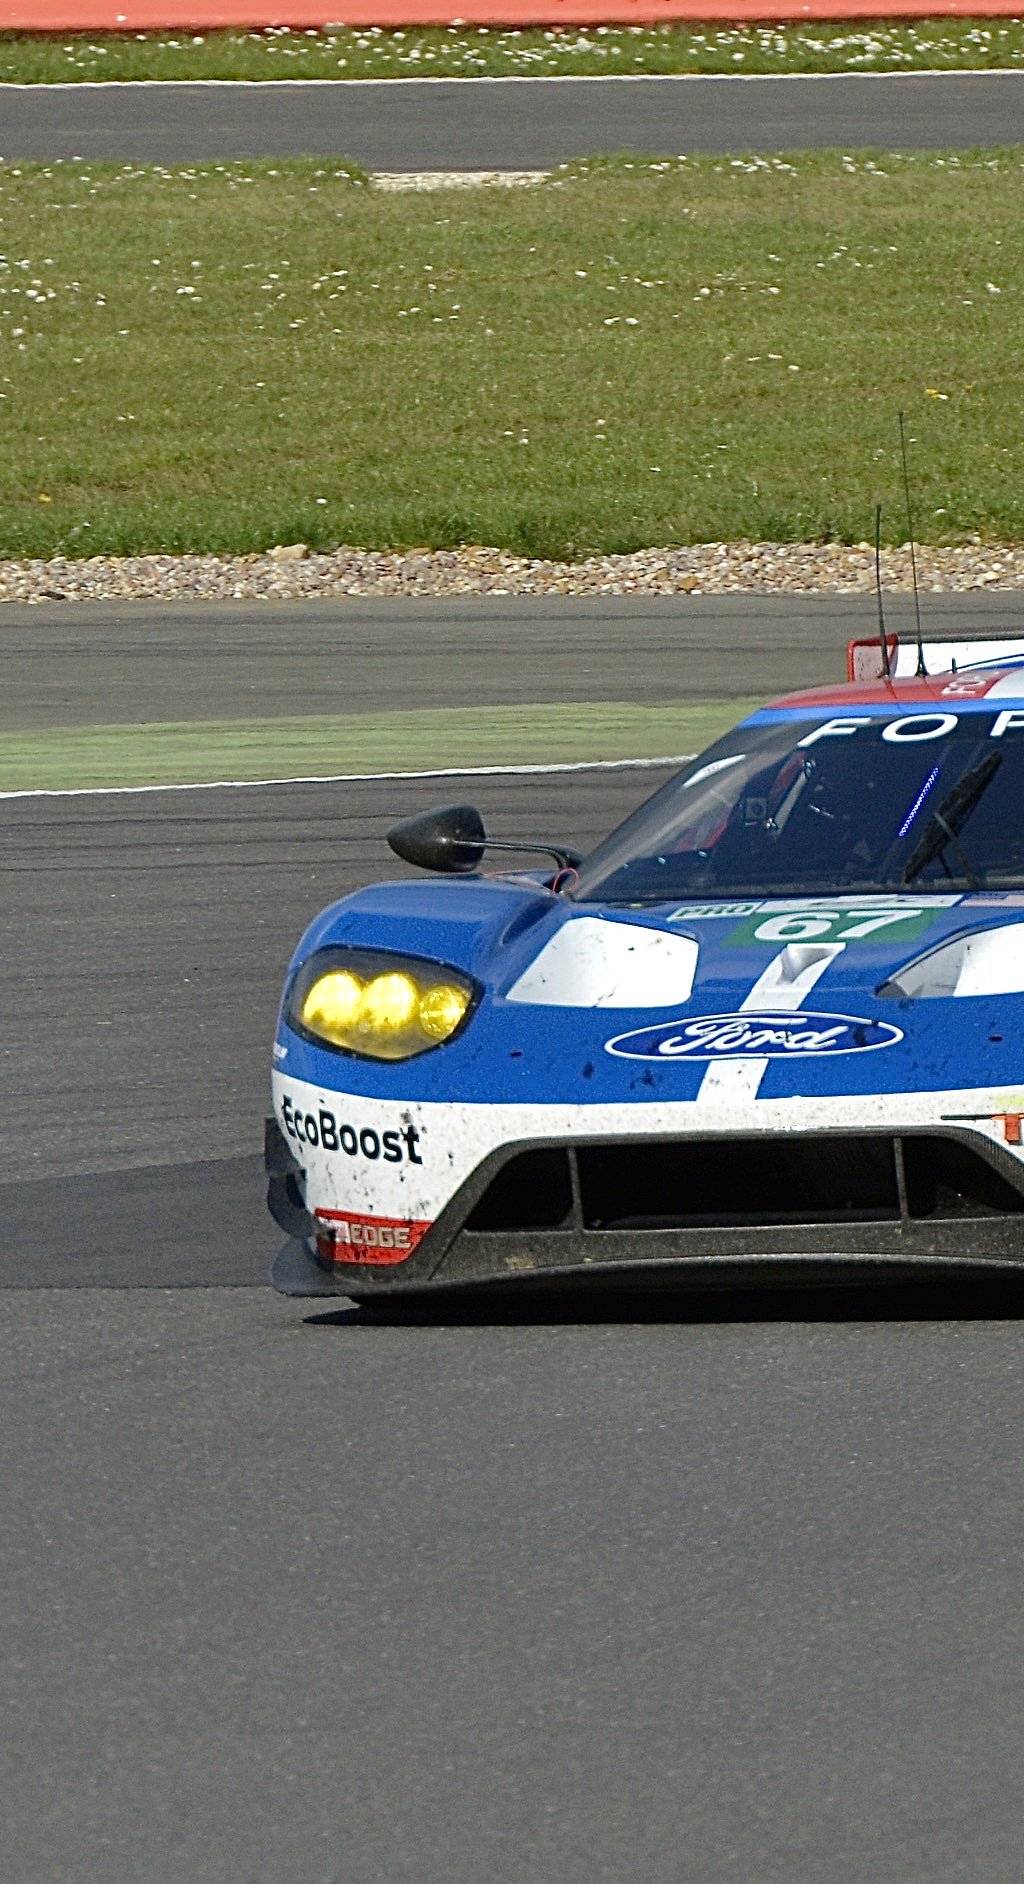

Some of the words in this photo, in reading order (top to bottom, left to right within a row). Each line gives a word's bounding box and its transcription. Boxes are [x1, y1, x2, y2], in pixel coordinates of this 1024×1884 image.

[679, 904, 748, 918] PRO
[754, 909, 923, 941] 67
[660, 1017, 849, 1055] Ford
[282, 1094, 423, 1165] EcoBoost
[351, 1223, 412, 1248] EDGE
